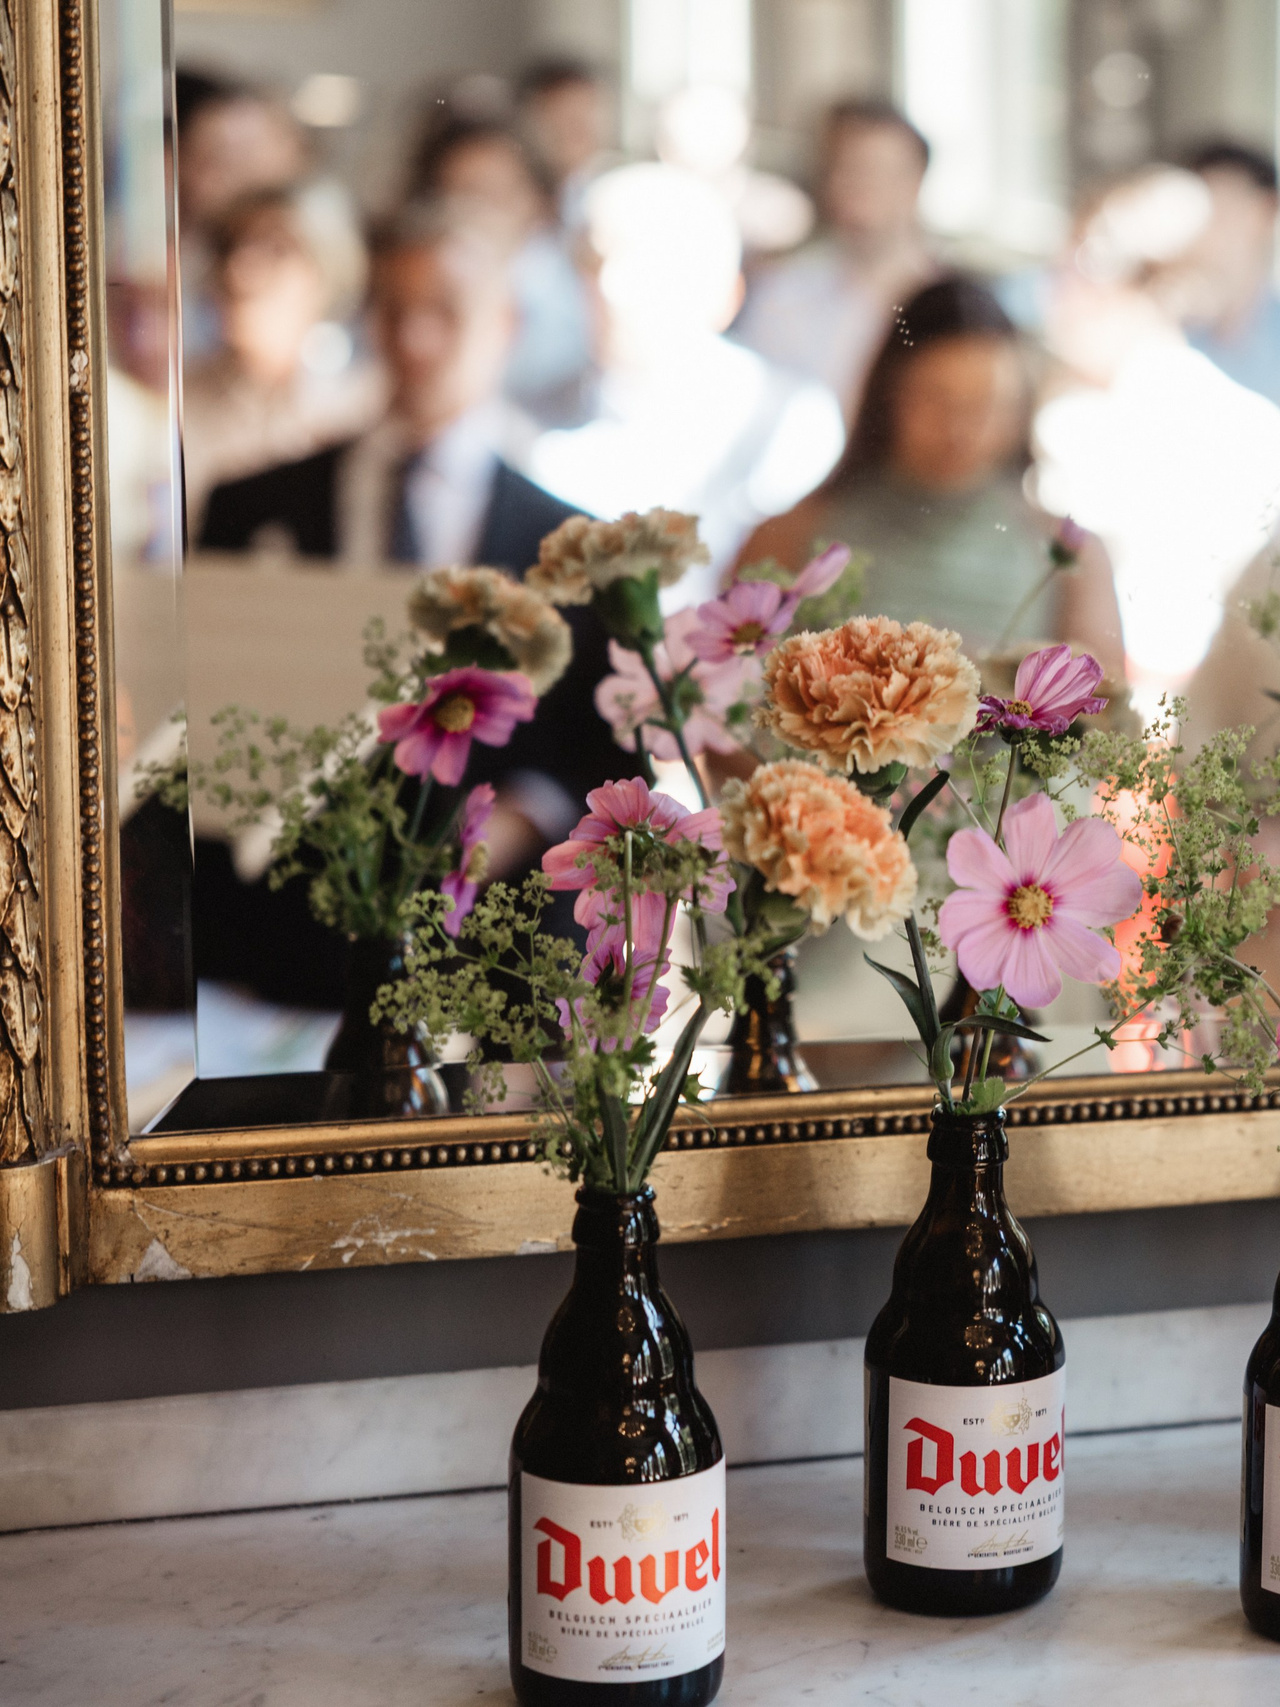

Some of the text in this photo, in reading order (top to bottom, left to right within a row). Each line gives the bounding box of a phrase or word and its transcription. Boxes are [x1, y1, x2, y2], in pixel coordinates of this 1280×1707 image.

[1035, 1408, 1047, 1417] 1871
[920, 1488, 1062, 1514] BELGISCH SPECIAALBIER
[932, 1518, 960, 1527] BIÈRE
[984, 1513, 1035, 1526] SPÉCIALITÉ
[894, 1532, 905, 1545] 330
[907, 1536, 915, 1548] ml
[533, 1507, 721, 1605] Duvel
[549, 1598, 712, 1624] BELGISCH SPECIAALBIER
[561, 1626, 589, 1637] BIÈRE
[615, 1625, 675, 1638] SPÉCIALITÉ
[681, 1616, 704, 1630] BELGE
